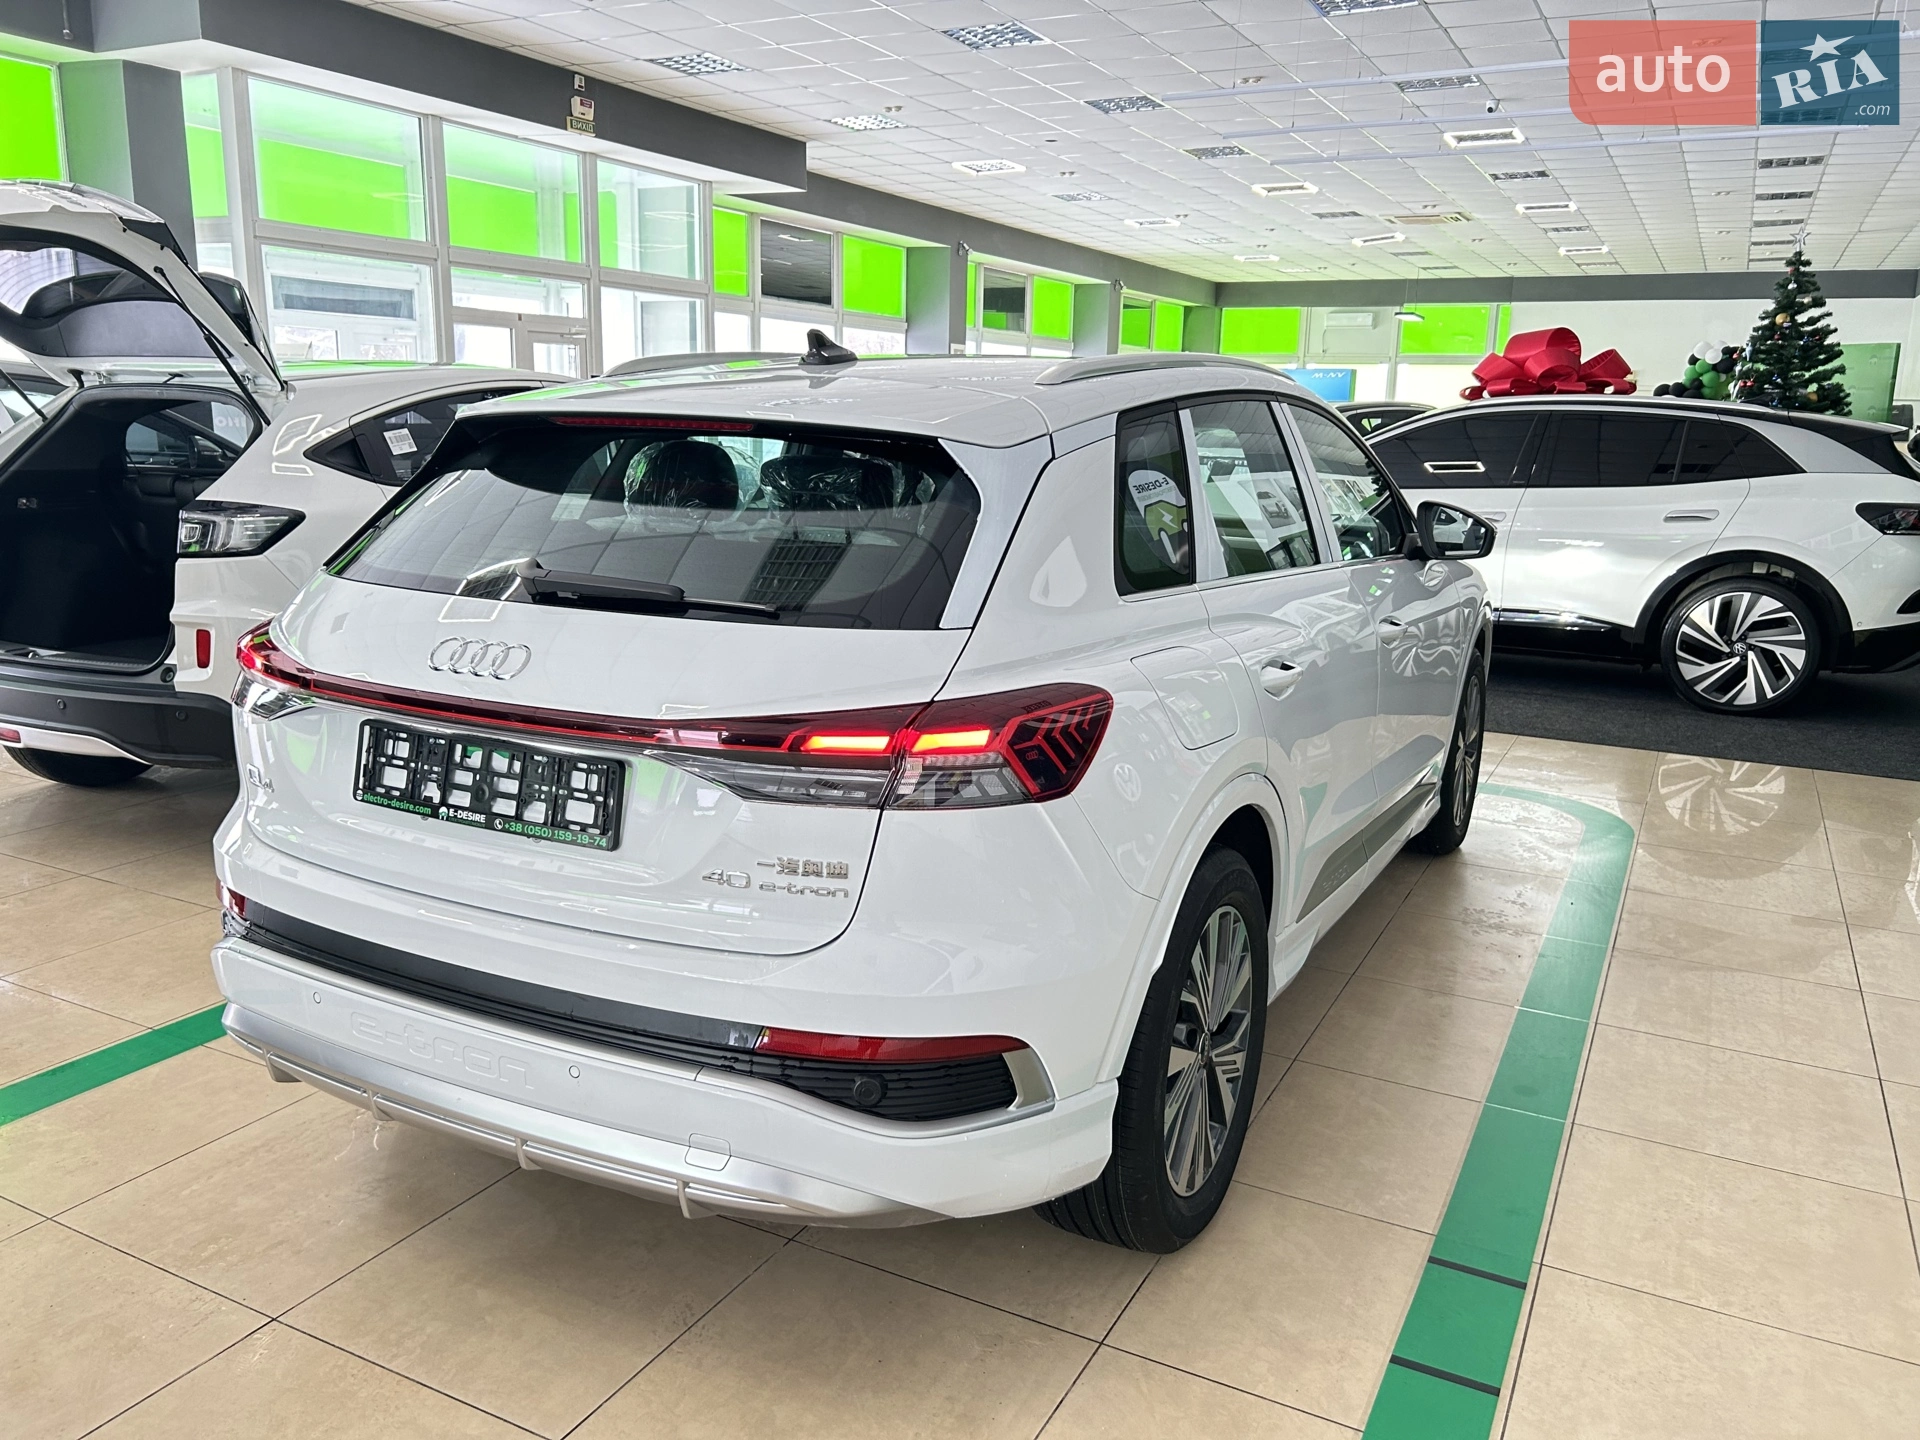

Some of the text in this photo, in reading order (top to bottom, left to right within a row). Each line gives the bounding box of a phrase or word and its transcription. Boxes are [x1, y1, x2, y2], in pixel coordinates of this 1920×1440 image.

[572, 120, 594, 133] ВИХІД
[363, 792, 432, 815] electro-desire.com
[449, 808, 486, 823] E-DESIRE
[504, 822, 607, 847] +38 (050) 159-19-74
[702, 869, 849, 898] 40 e-tron
[350, 1011, 535, 1090] e-tron
